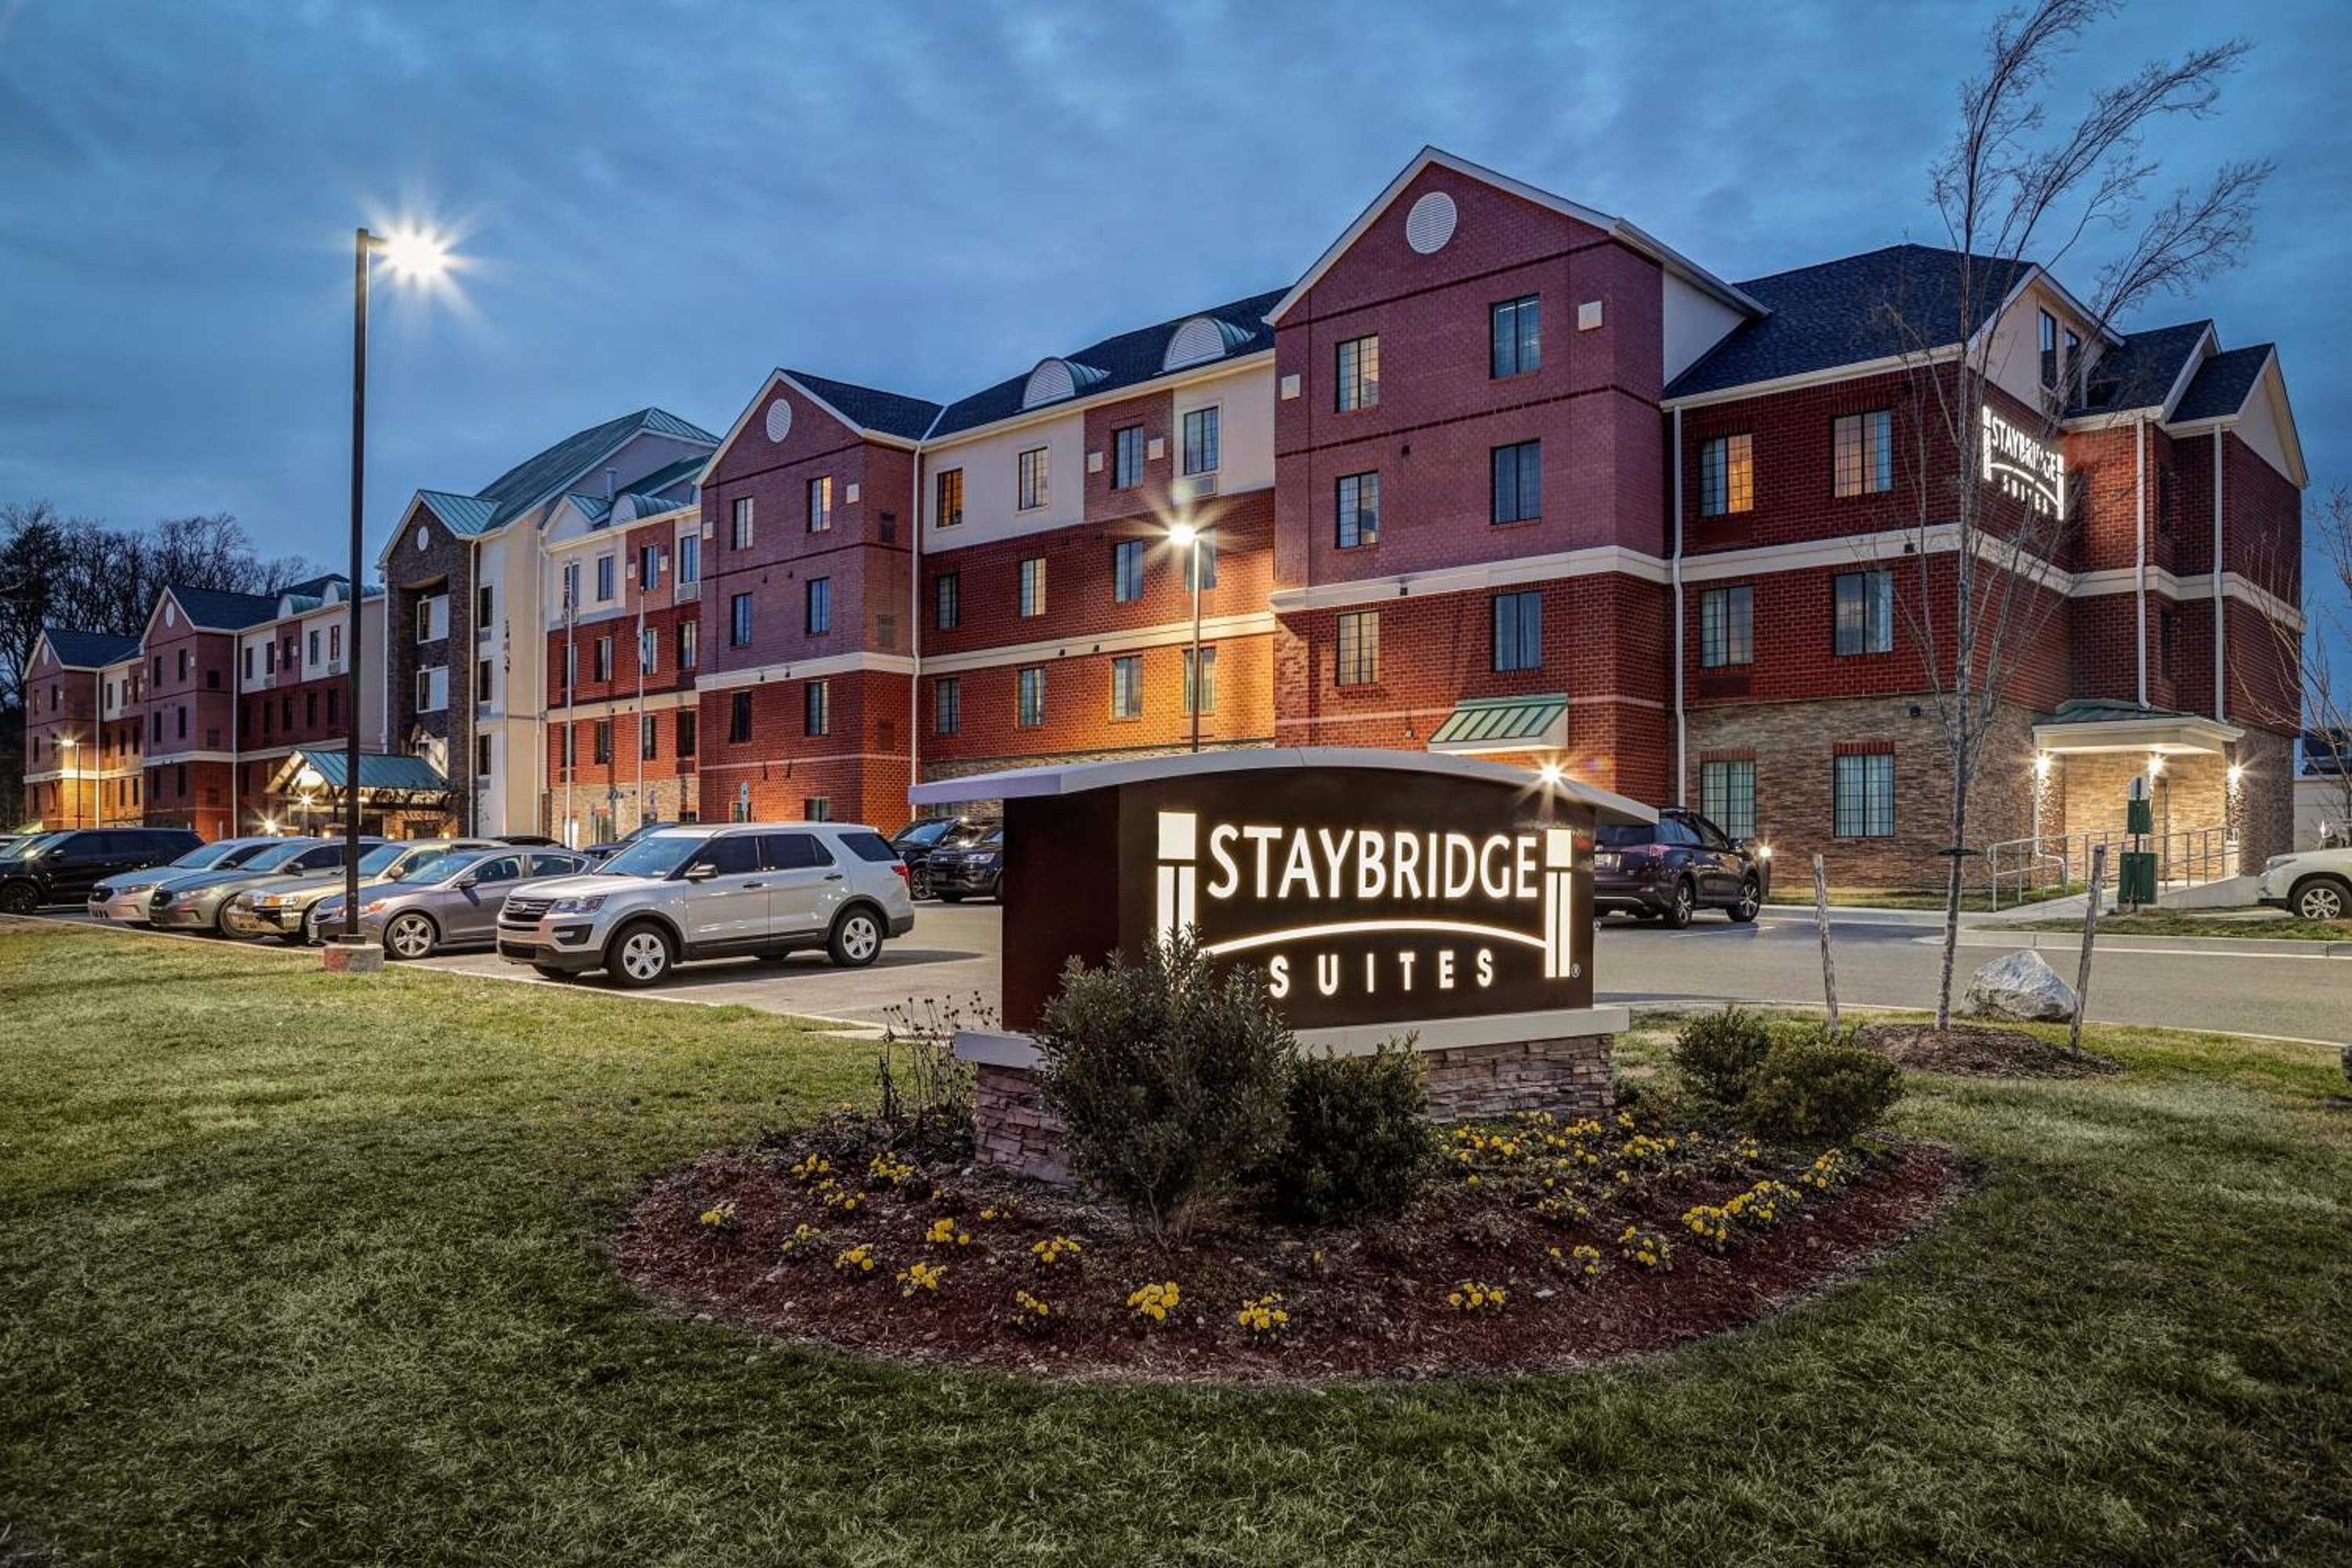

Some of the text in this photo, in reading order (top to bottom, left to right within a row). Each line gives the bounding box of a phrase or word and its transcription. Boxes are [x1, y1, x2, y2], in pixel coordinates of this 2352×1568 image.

[1992, 416, 2056, 482] STAYBRIDGE
[2003, 474, 2049, 514] SUITES
[1207, 824, 1537, 898] STAYBRIDGE
[1269, 948, 1493, 998] SUITES
